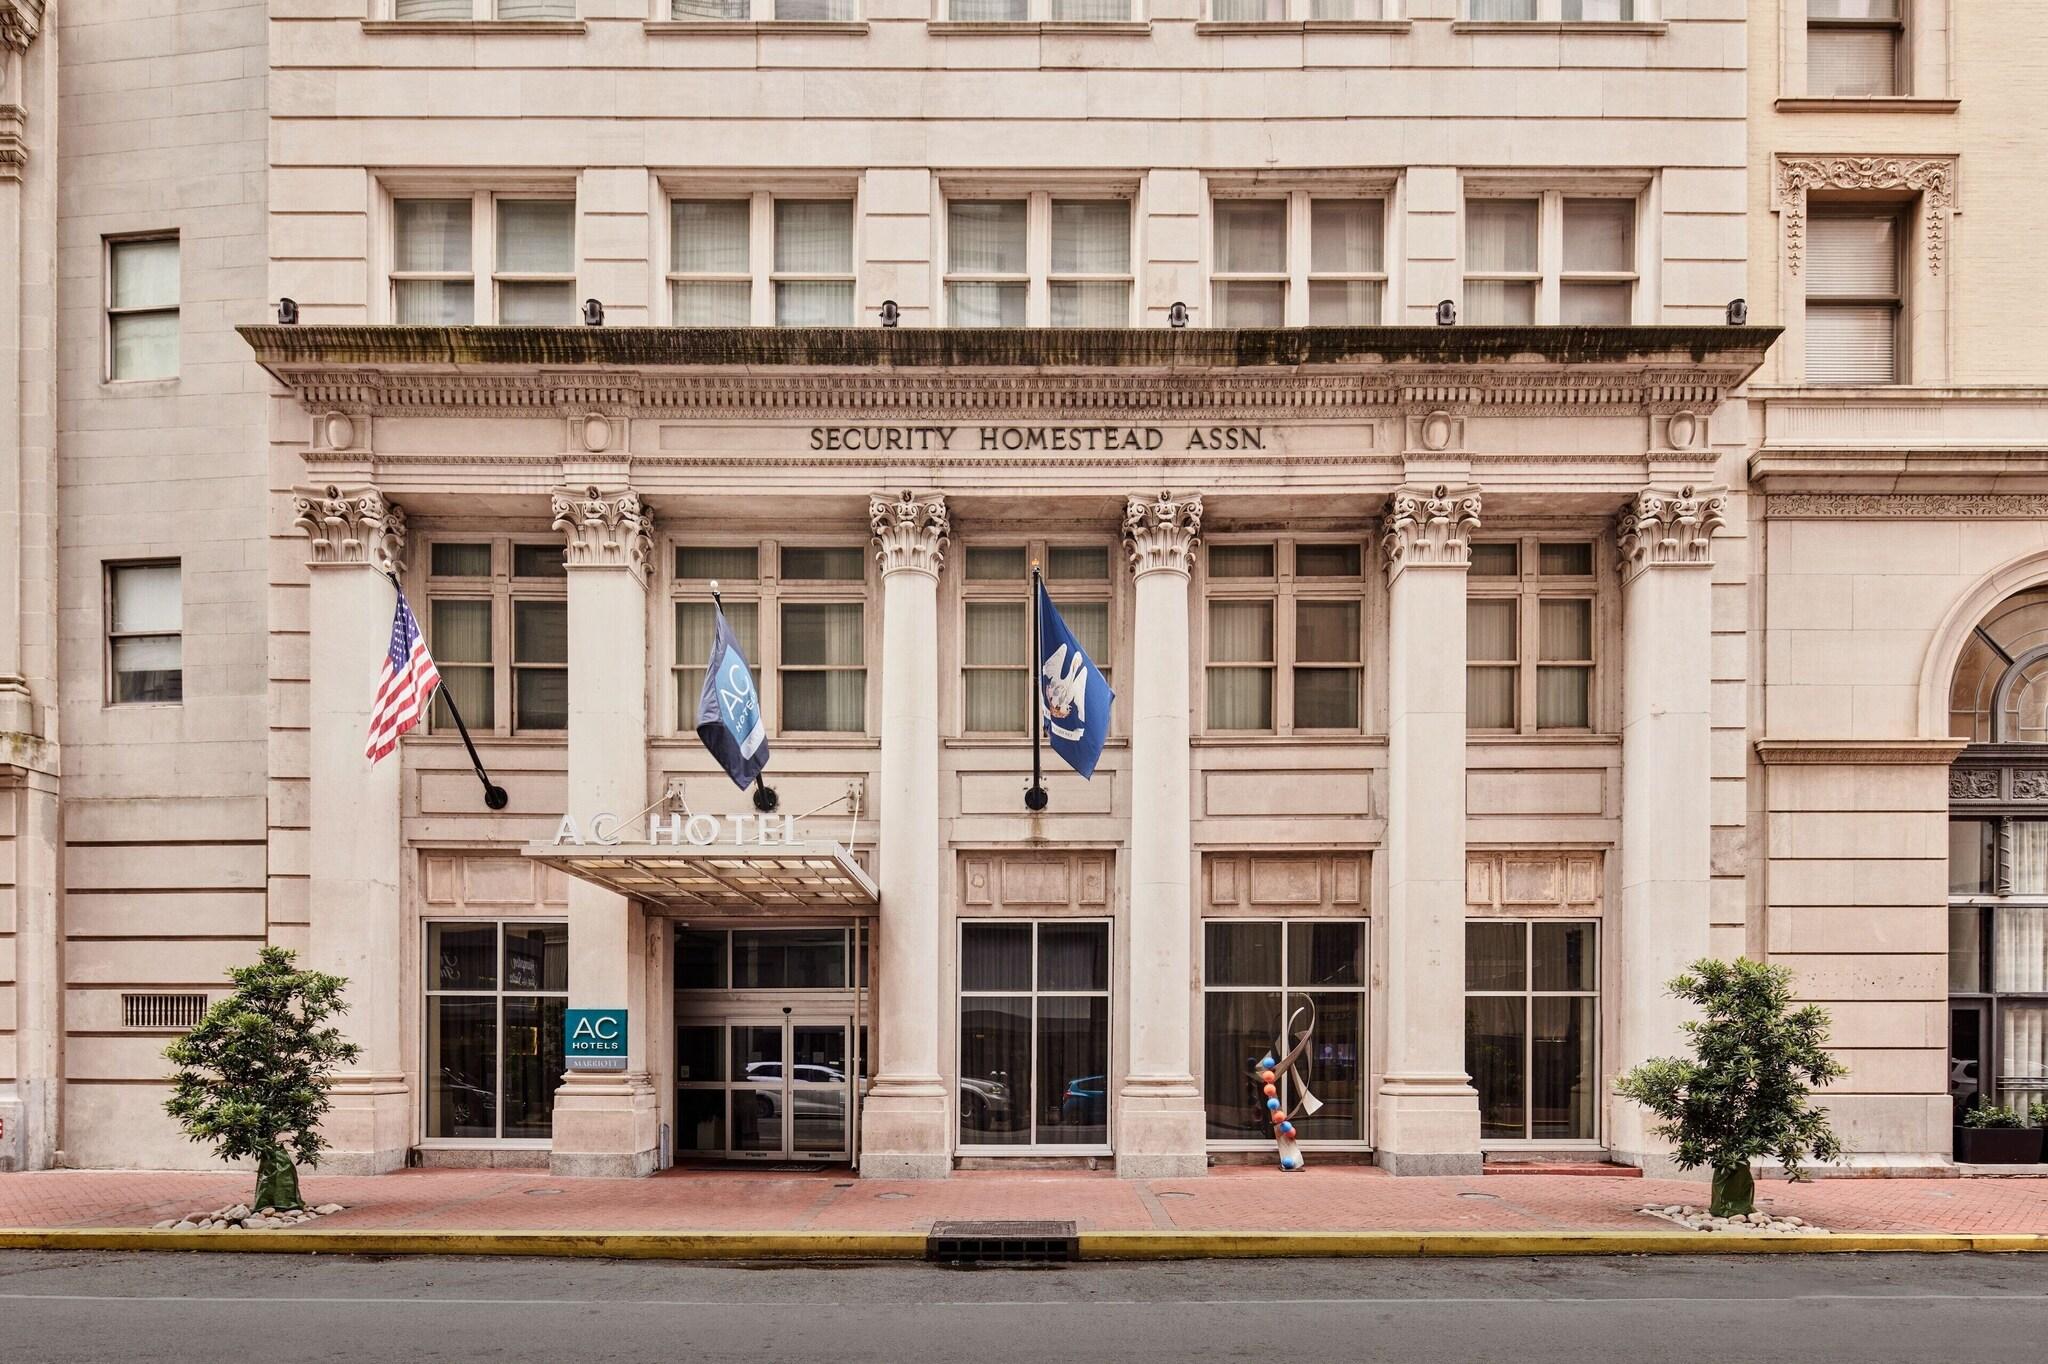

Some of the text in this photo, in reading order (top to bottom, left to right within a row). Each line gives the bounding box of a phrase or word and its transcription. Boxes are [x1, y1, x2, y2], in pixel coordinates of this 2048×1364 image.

[810, 426, 1267, 451] SECURITY HOMESTEAD ASSN.
[720, 664, 750, 721] AC
[552, 812, 805, 846] AC HOTEL
[572, 1016, 618, 1039] AC
